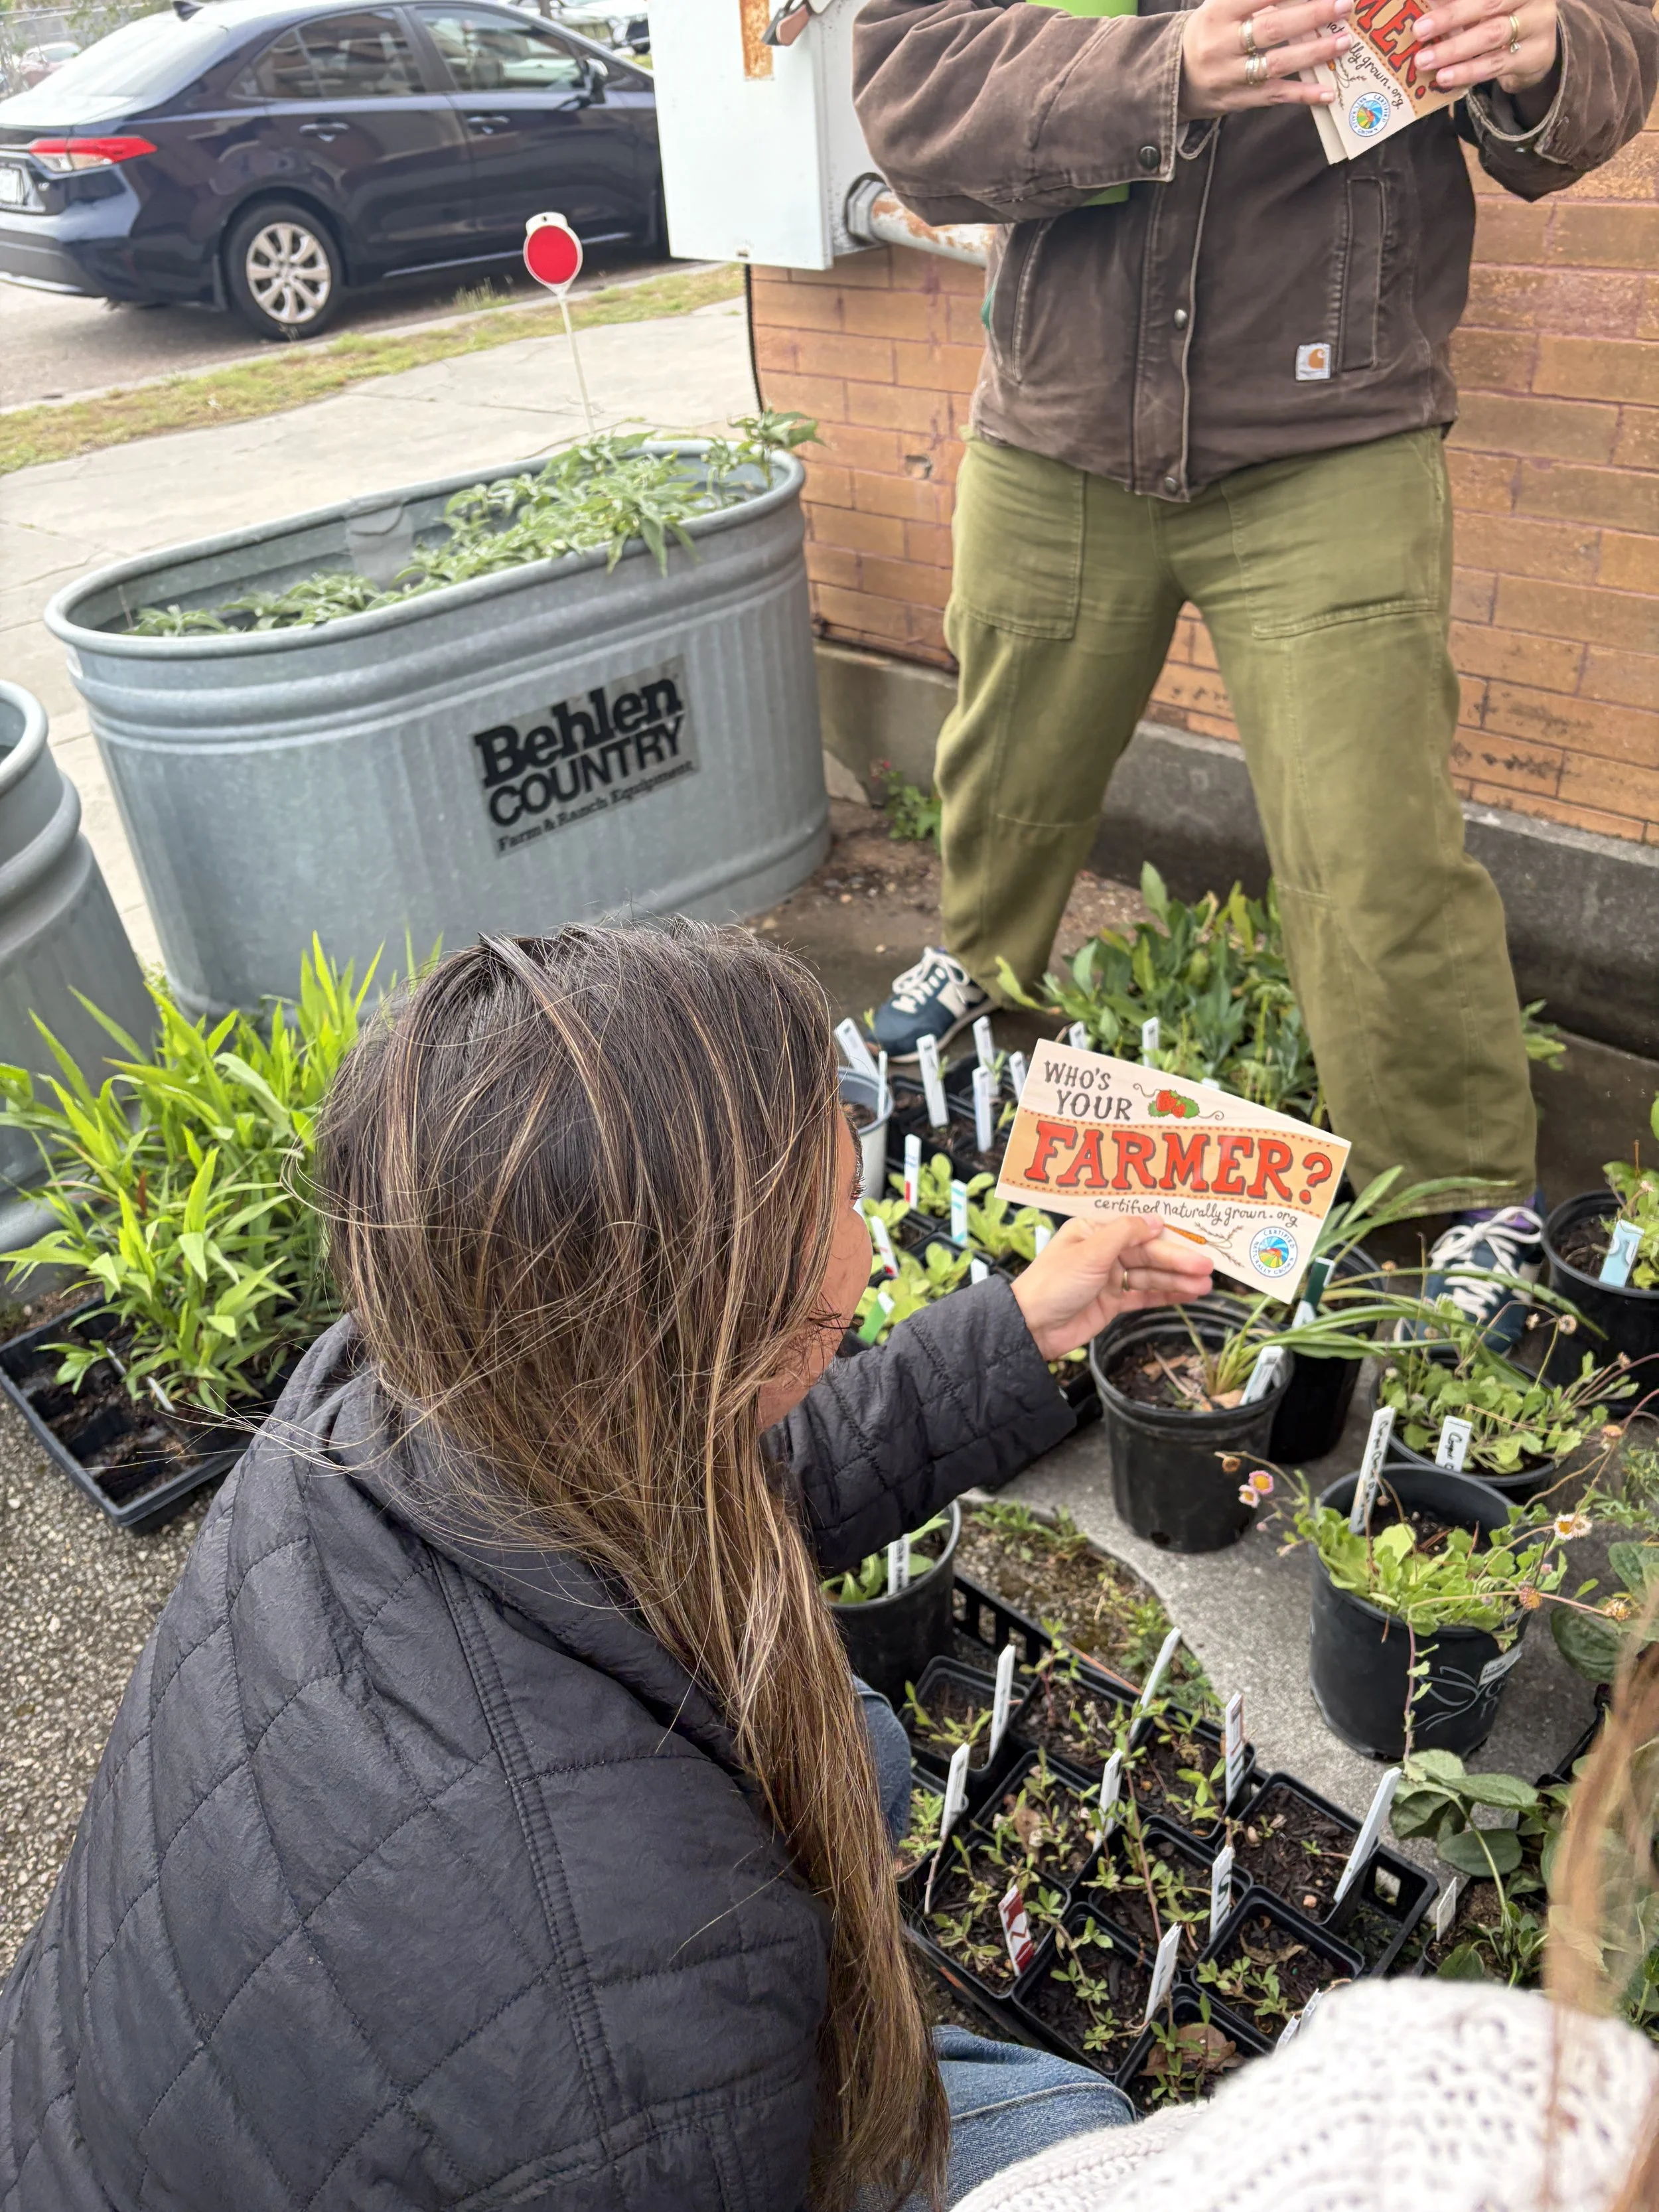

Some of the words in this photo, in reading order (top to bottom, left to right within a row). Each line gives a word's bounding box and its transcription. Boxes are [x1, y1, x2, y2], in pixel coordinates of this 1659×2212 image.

[474, 678, 683, 788] Behlen
[489, 715, 684, 827] COUNTRY
[497, 826, 541, 851] Farm
[543, 819, 555, 831] &
[557, 797, 609, 826] Ranch
[1043, 1060, 1112, 1090] WHO'S
[1056, 1088, 1133, 1122] YOUR
[1023, 1120, 1334, 1204] FARMER?
[1094, 1198, 1160, 1214] certified
